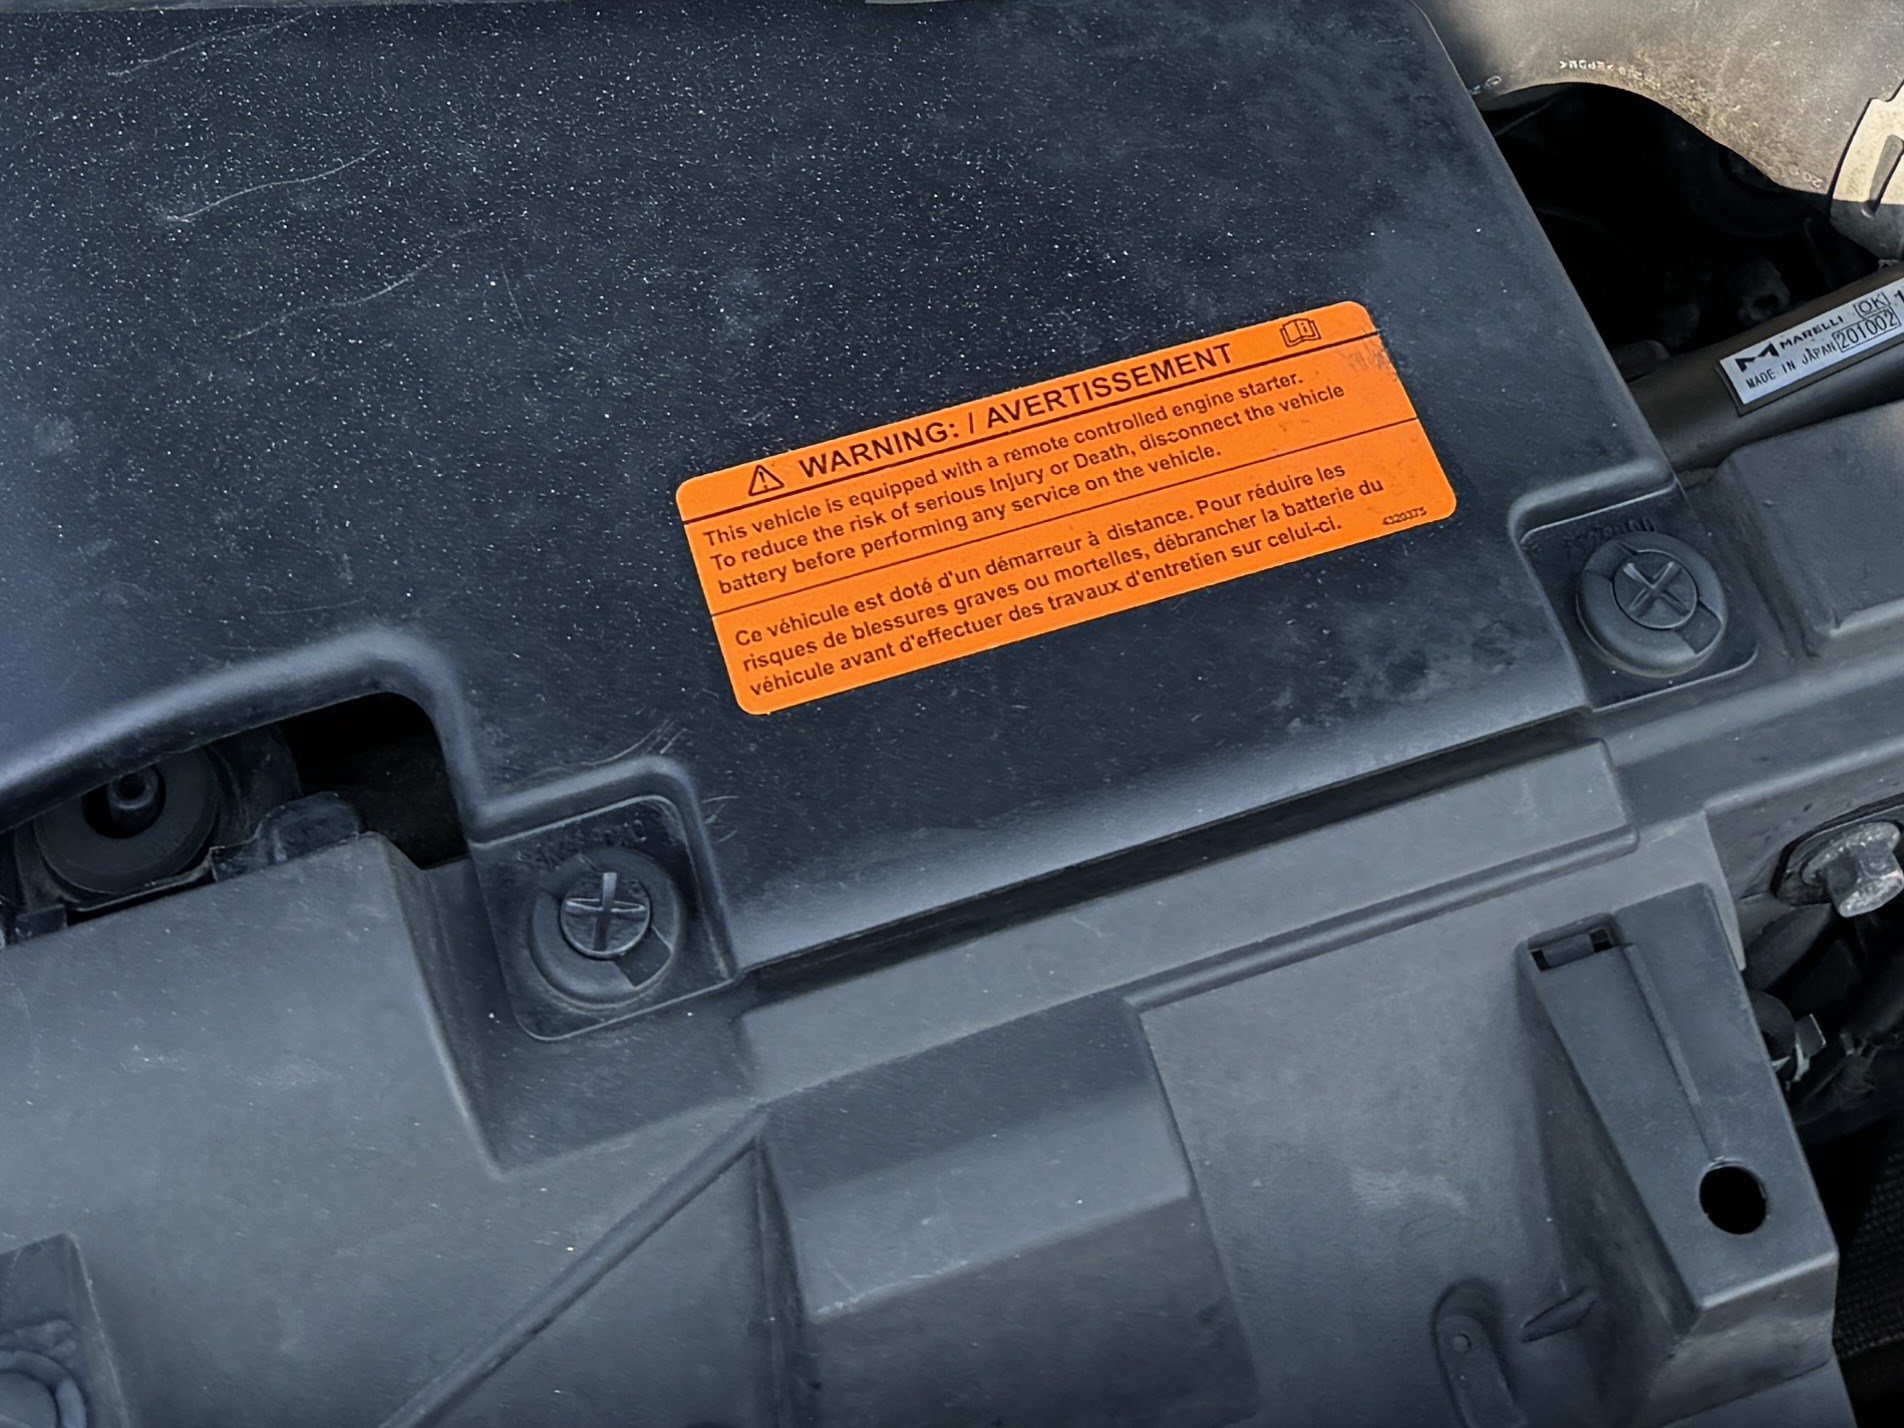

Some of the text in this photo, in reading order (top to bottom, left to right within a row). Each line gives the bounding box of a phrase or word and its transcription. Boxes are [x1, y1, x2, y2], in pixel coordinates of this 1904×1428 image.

[1746, 308, 1898, 389] MADE IN JAPAN 201002
[1780, 292, 1890, 350] MARELLI OK
[702, 372, 1303, 546] This vehicle is equipped with a remote controlled engine starter.
[709, 385, 1345, 570] To reduce the risk of serious Injury or Death, disconnect the vehicle
[797, 341, 1231, 478] WARNING: / AVERTISSEMENT
[717, 444, 1221, 594] battery before performing any service on the vehicle.
[734, 464, 1346, 646] Ce véhicule est doté d'un démarreur à distance. Pour réduire les
[742, 479, 1384, 672] risques de blessures graves ou mortelles, débrancher la batterie du
[749, 515, 1342, 696] véhicule avant d'effectuer des travaux d'entretien sur celui-ci.
